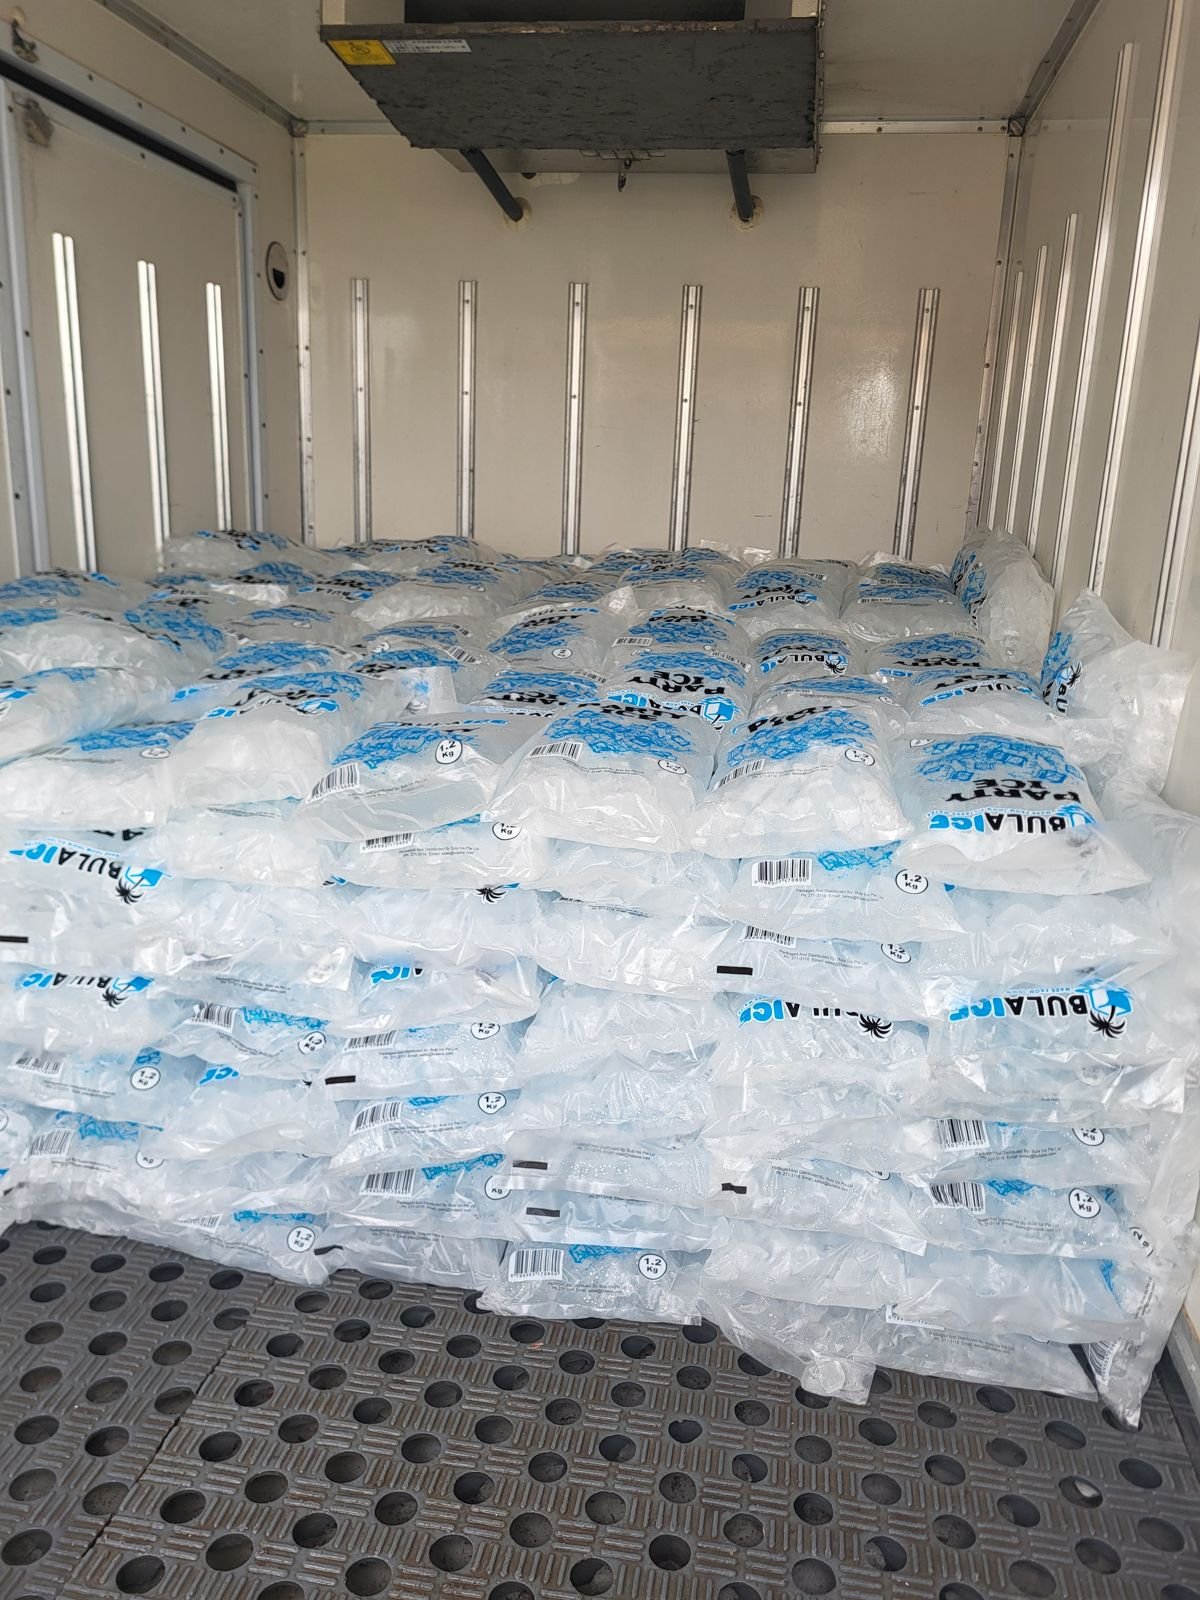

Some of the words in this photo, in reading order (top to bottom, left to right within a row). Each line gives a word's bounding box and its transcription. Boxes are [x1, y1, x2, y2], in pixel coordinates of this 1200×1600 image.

[652, 670, 704, 685] ICE
[626, 676, 725, 695] PARTY
[440, 741, 456, 752] 1.2
[973, 779, 1047, 790] ICE
[945, 789, 1082, 803] PARTY
[928, 812, 1067, 834] BULAICE
[902, 873, 922, 883] 1.2
[905, 882, 918, 890] Kg
[888, 944, 905, 954] 1.2
[889, 951, 902, 960] Kg
[140, 1070, 157, 1080] 1.2
[1083, 1132, 1096, 1141] Kg
[1074, 1192, 1094, 1203] 1.2
[1078, 1203, 1092, 1213] Kg
[296, 1230, 313, 1241] 1.2
[644, 1258, 662, 1266] 1.2
[646, 1266, 659, 1274] Kg
